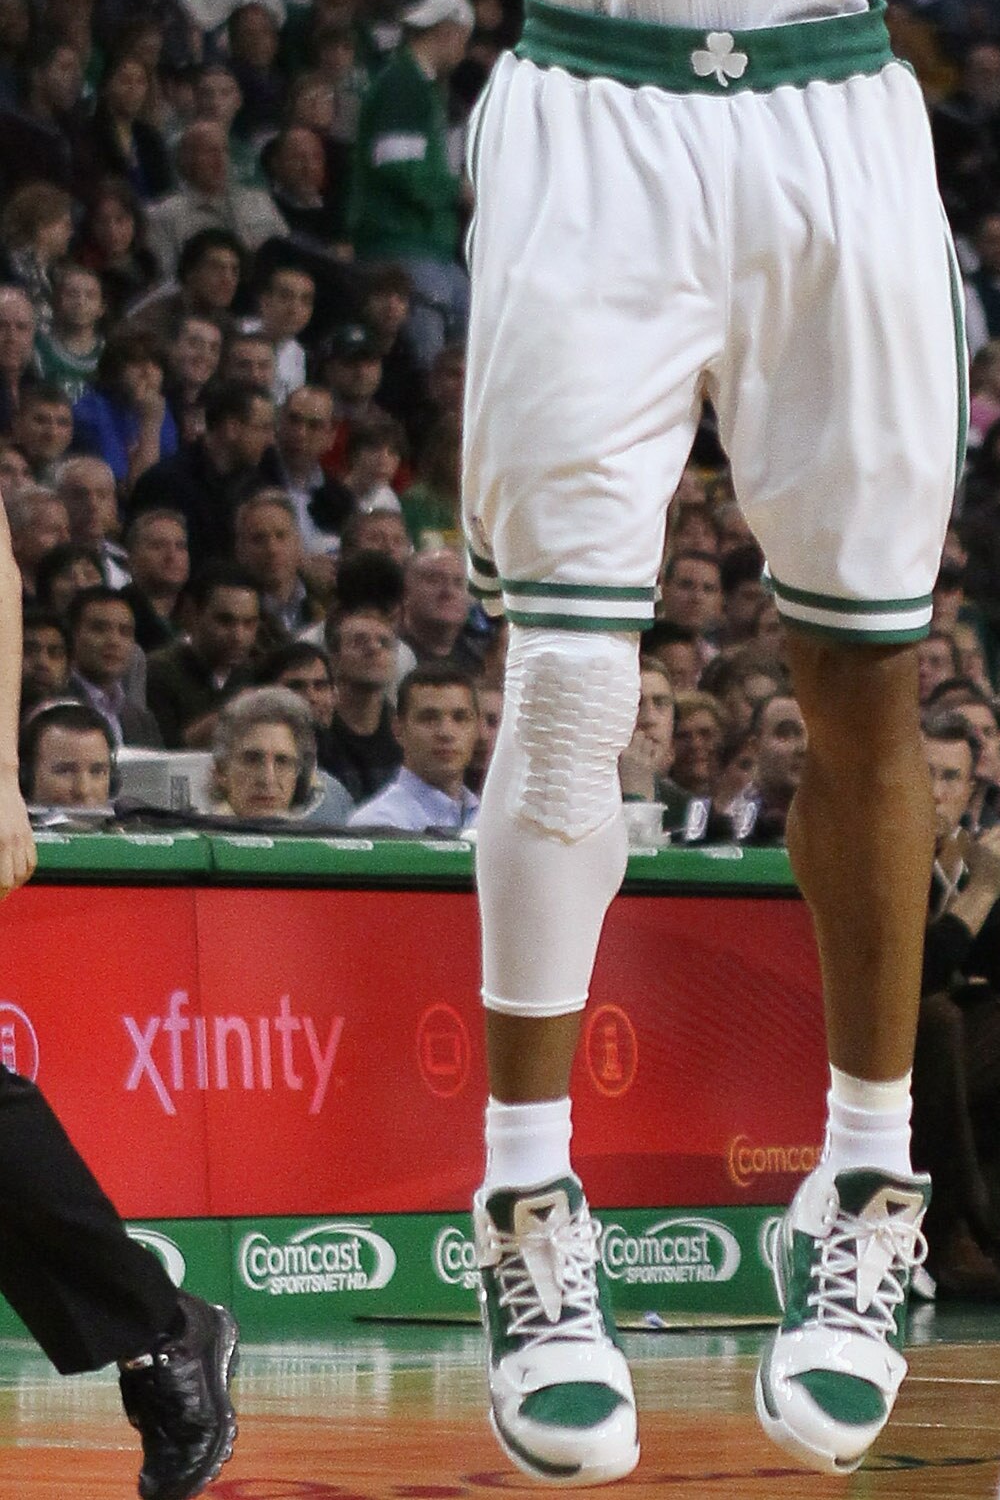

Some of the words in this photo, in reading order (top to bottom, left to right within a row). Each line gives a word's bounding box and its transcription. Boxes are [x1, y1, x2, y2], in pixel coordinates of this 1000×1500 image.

[121, 990, 346, 1116] xfinity
[269, 1274, 346, 1295] SPORTSNET
[627, 1265, 698, 1284] SPORTSNET
